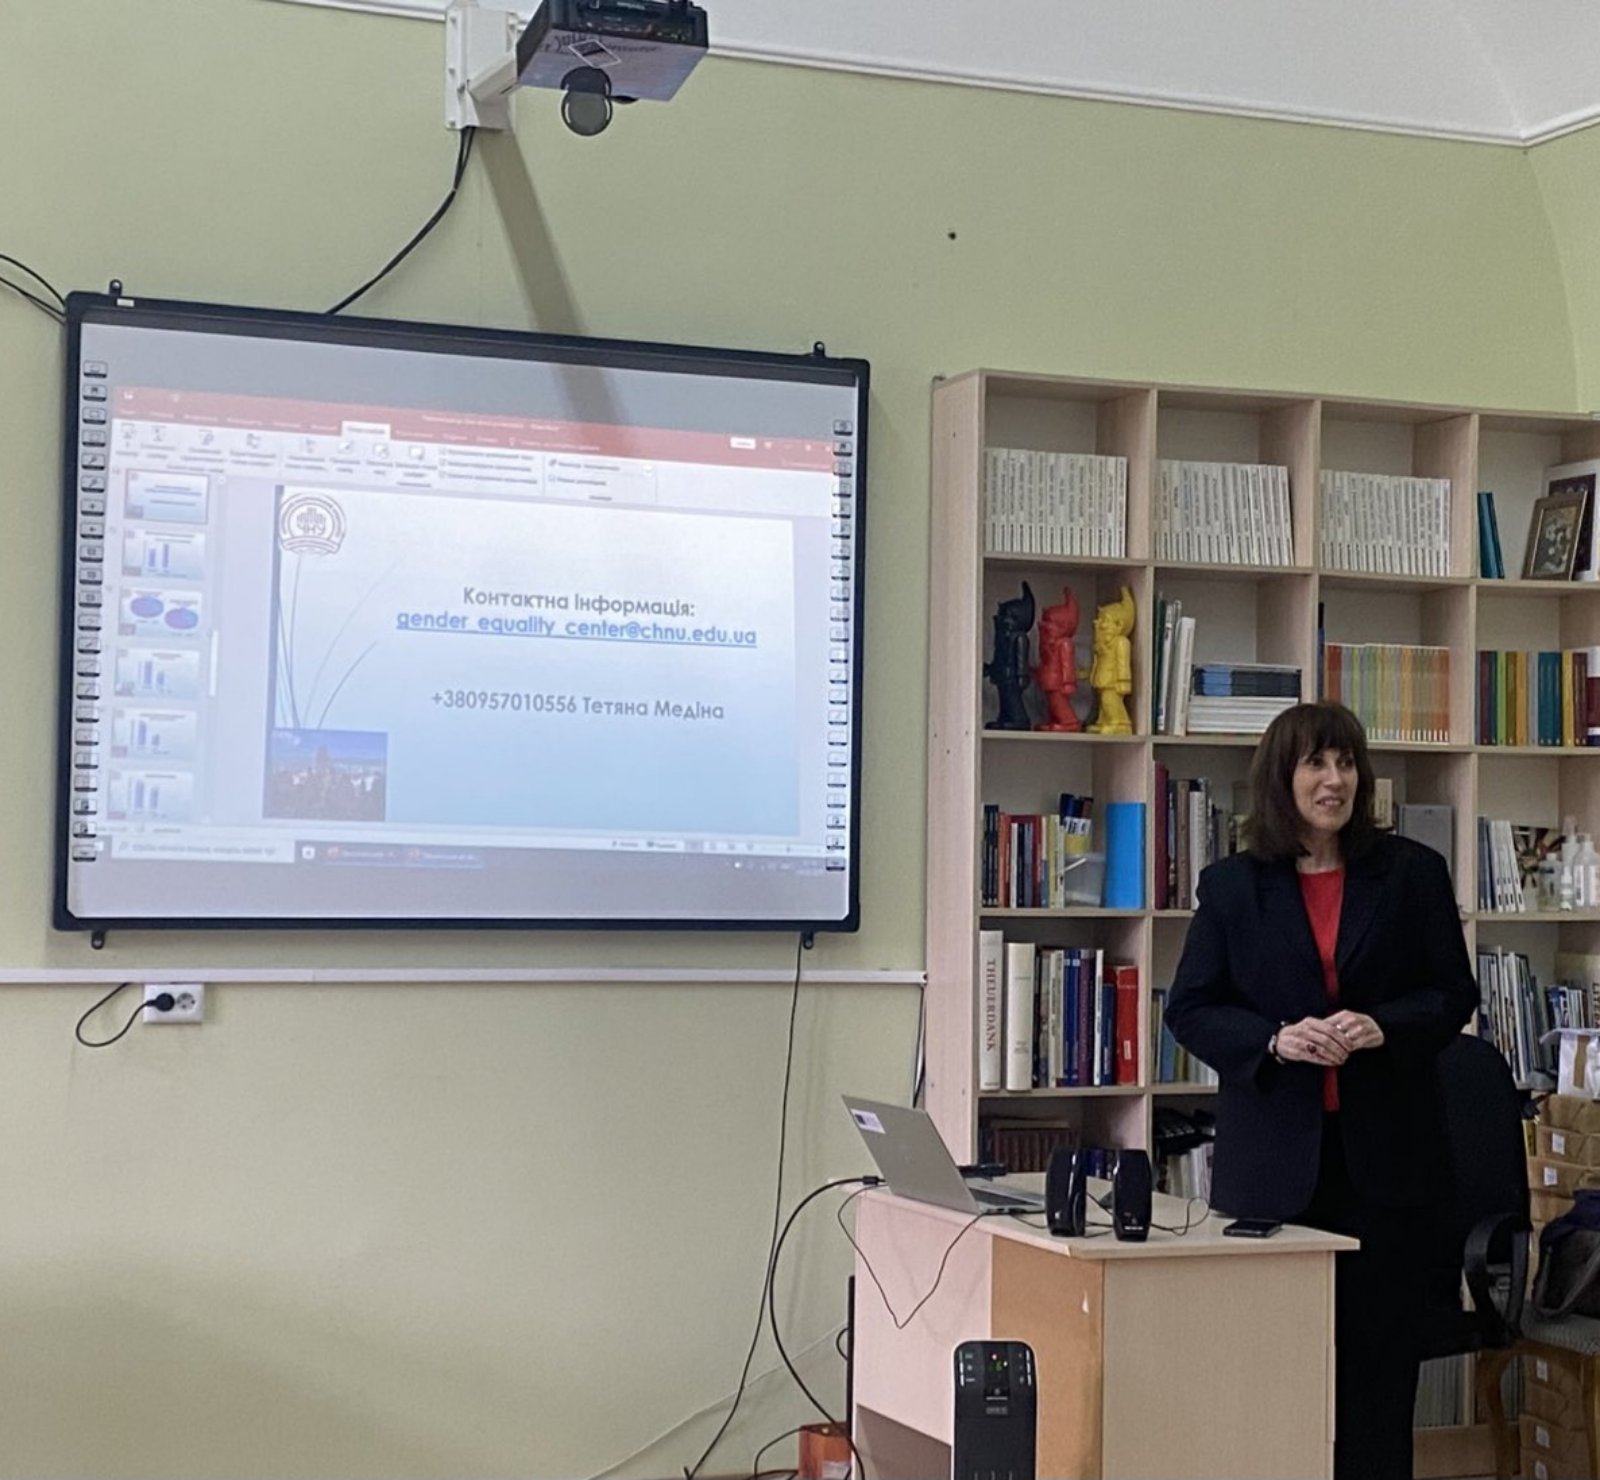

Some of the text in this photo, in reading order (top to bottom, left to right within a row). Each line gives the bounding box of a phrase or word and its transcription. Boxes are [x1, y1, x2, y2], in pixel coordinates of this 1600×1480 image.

[463, 587, 569, 610] Контактна
[432, 690, 724, 720] +380957010556 Тетяна Медіна
[986, 957, 997, 1052] THEUERDANK
